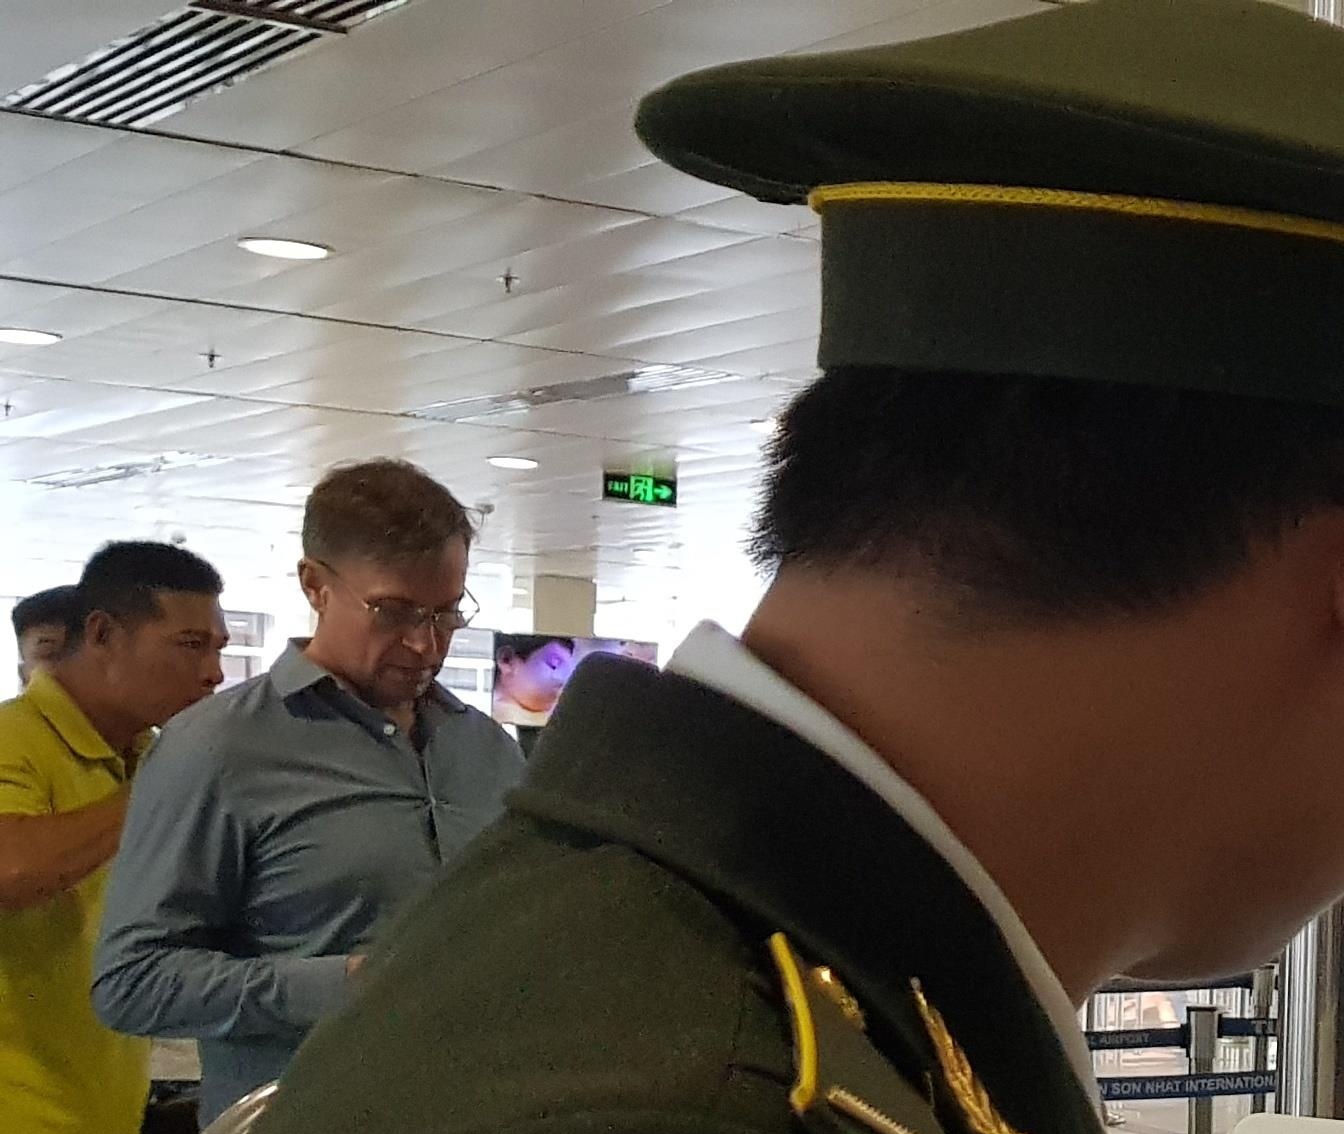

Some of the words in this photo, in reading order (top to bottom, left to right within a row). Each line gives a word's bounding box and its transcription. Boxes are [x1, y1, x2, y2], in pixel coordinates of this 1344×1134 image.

[1111, 1081, 1142, 1095] SON
[1145, 1080, 1181, 1093] NHAT
[1185, 1075, 1277, 1092] INTERNATION
